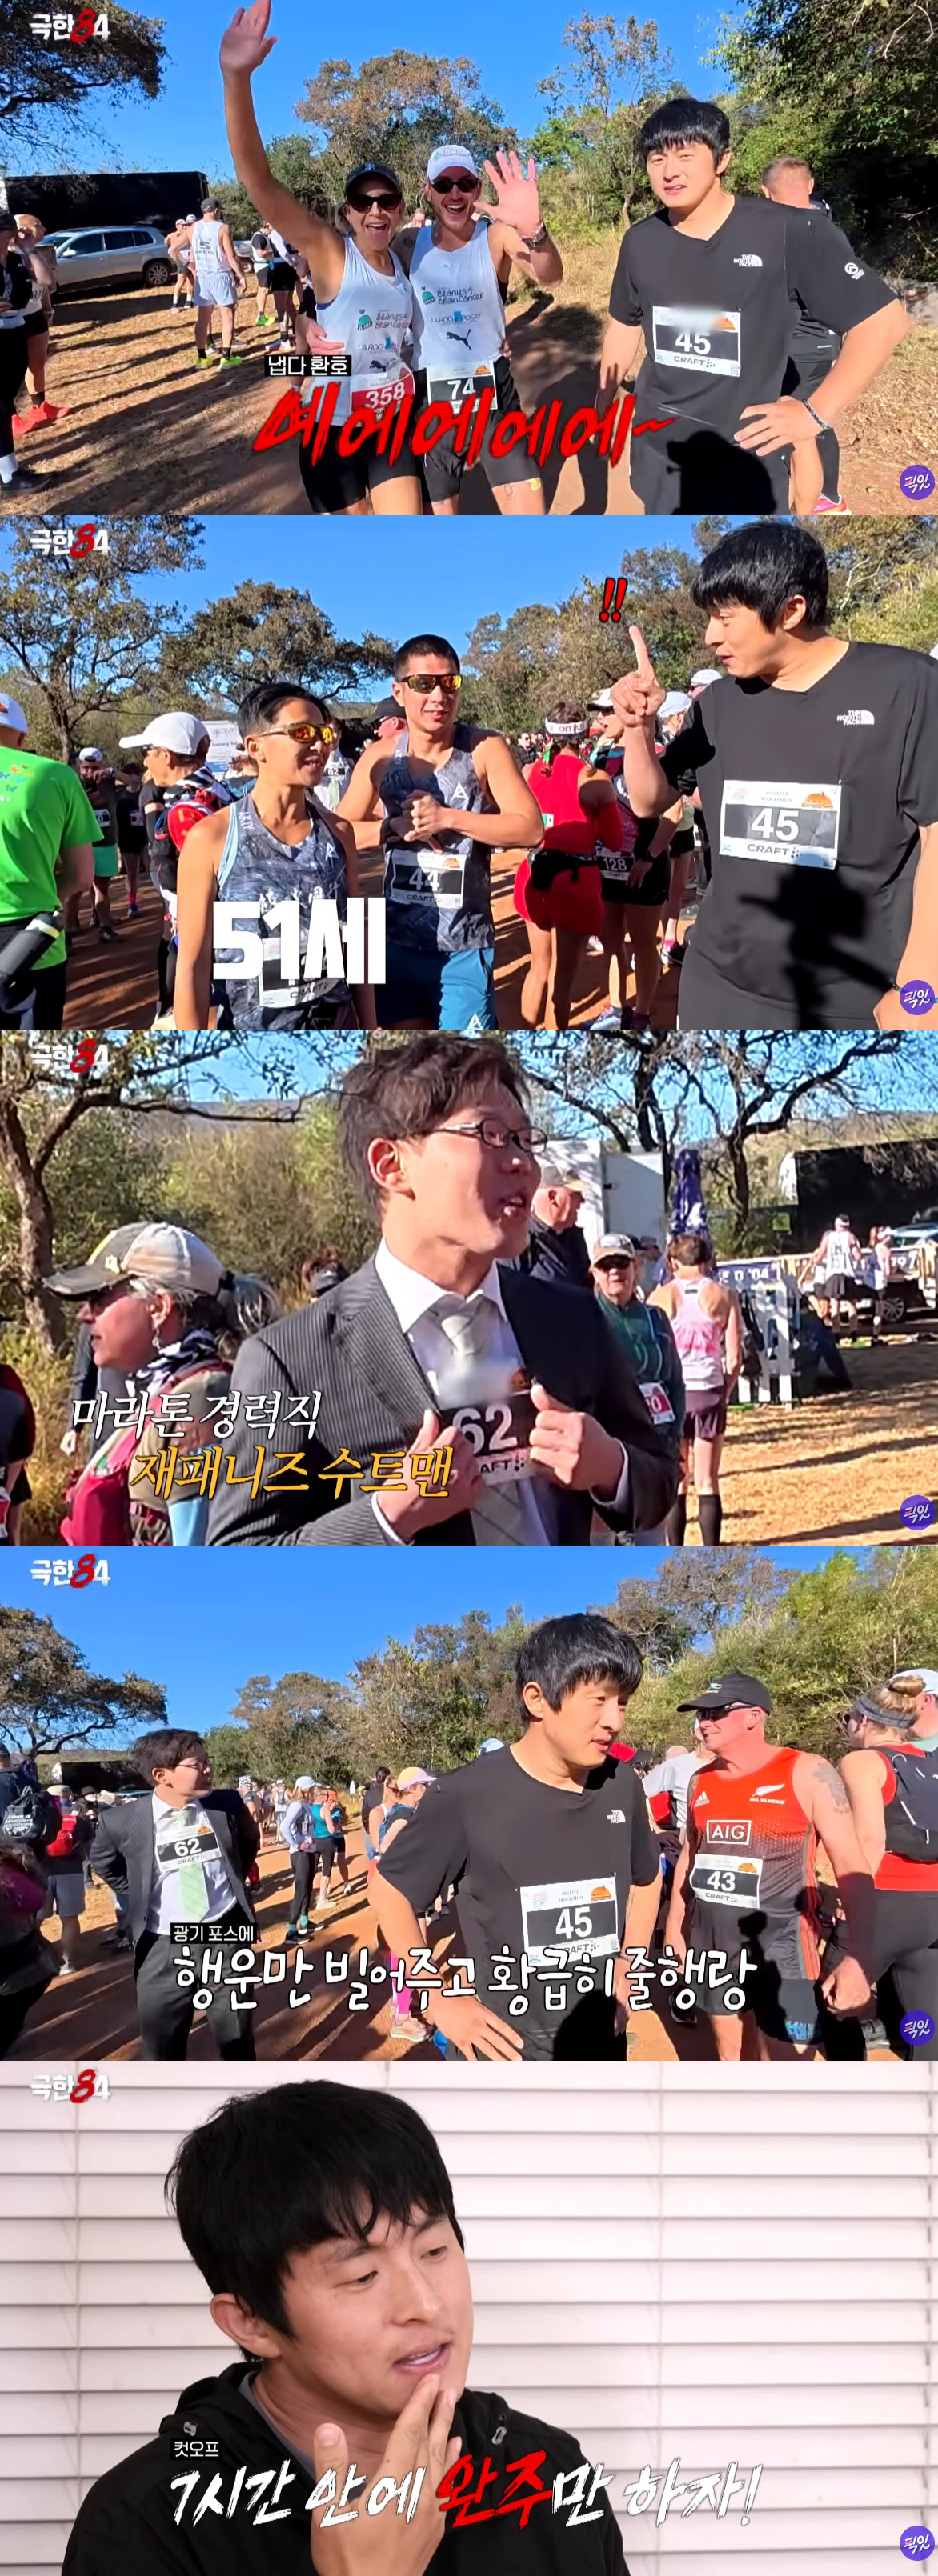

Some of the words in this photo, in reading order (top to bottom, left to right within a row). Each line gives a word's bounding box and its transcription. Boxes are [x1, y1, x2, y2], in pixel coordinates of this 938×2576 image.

[675, 331, 712, 355] 45
[674, 355, 706, 366] CRAFT
[365, 382, 406, 408] 358
[447, 378, 476, 400] 74
[751, 807, 800, 842] 45
[747, 843, 791, 856] CRAFT
[603, 857, 627, 871] 128
[409, 869, 440, 892] 44
[407, 894, 434, 902] CRAFT
[290, 980, 325, 999] CRAFT
[452, 1402, 518, 1454] 62
[480, 1458, 511, 1474] AFT
[711, 1824, 745, 1840] AIG
[174, 1838, 202, 1857] 62
[177, 1855, 200, 1866] CRAFT
[706, 1870, 736, 1892] 43
[705, 1892, 732, 1902] CRAFT
[555, 1906, 593, 1940] 45
[563, 1943, 590, 1955] RAFT
